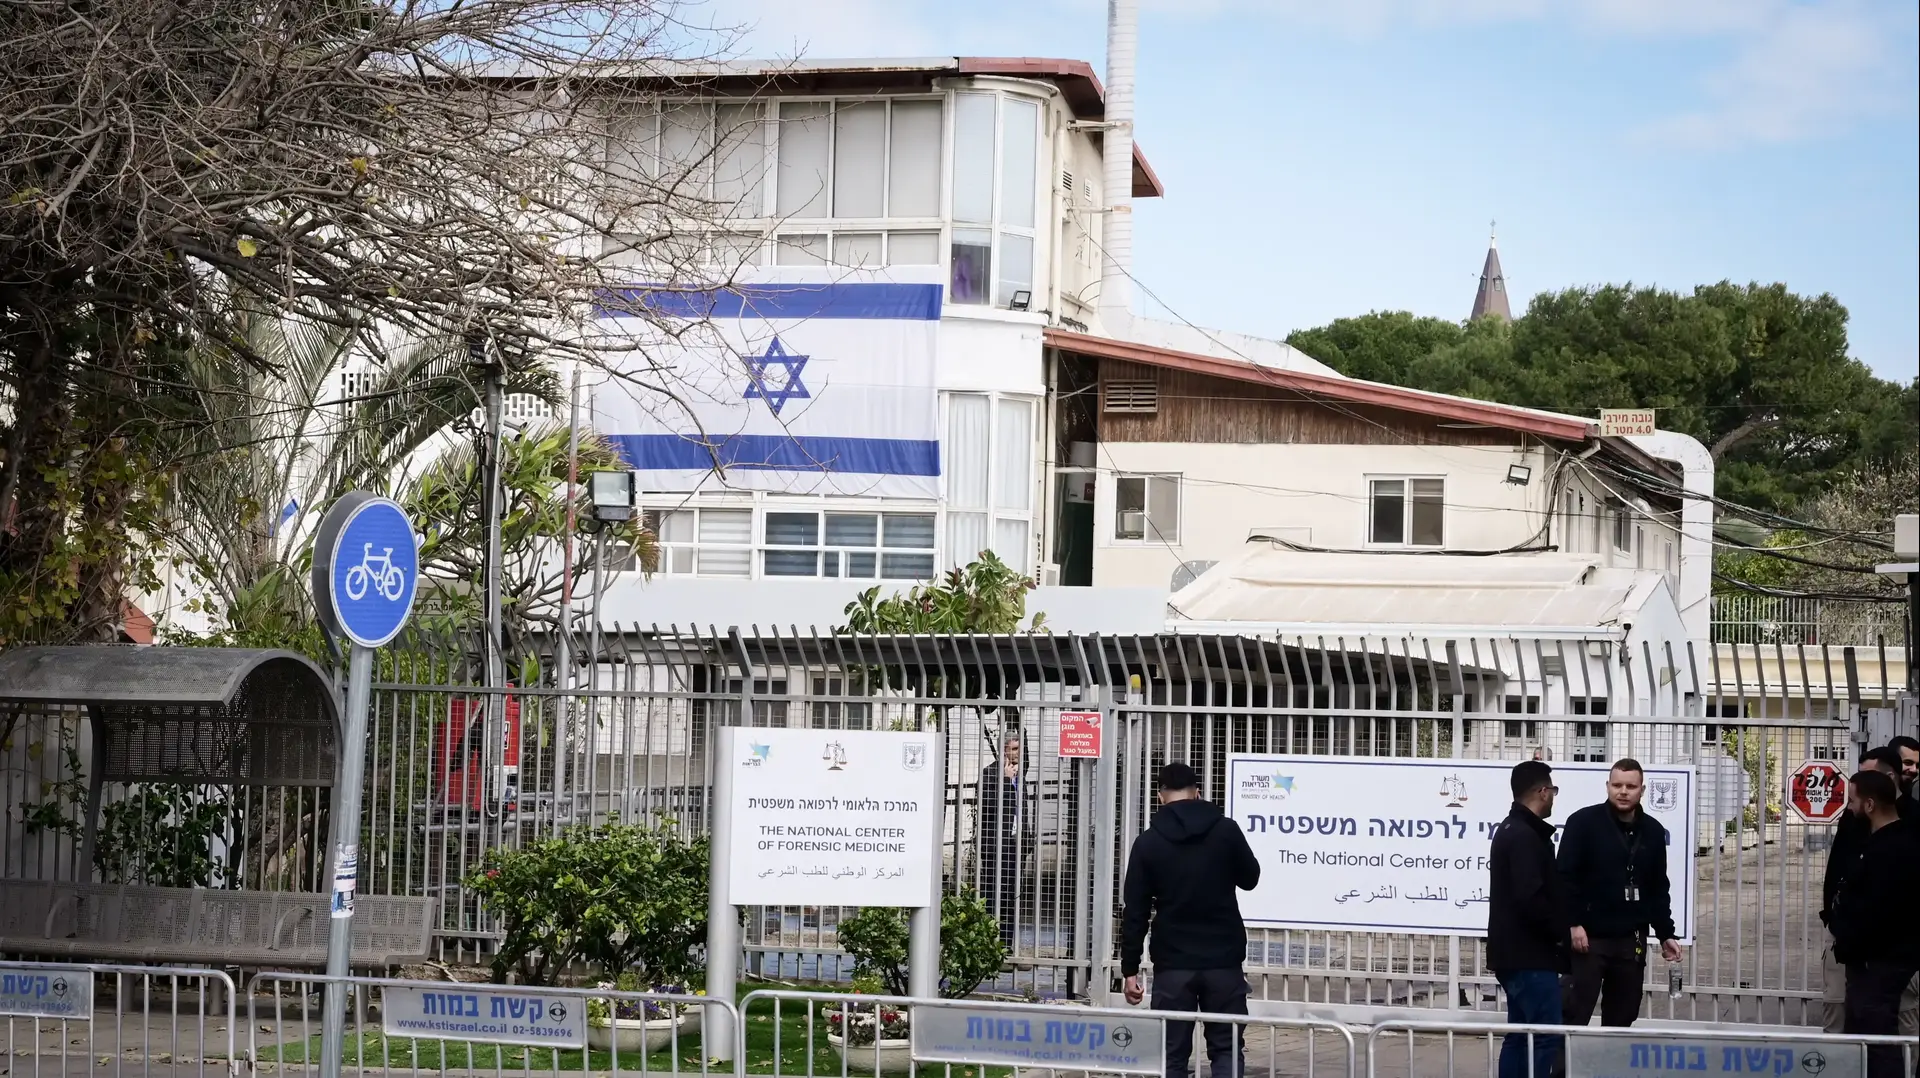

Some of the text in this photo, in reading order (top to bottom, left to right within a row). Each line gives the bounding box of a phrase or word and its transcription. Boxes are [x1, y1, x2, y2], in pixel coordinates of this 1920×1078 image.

[1604, 414, 1652, 423] גובה מירבי
[1614, 425, 1651, 434] 4.0 מטר
[748, 796, 918, 812] המרכז הלאומי לרפואה משפטית
[759, 826, 905, 838] THE NATIONAL CENTER
[1247, 814, 1357, 836] משפטית
[1369, 814, 1467, 839] לרפואה
[758, 841, 905, 853] OF FORENSIC MEDICINE
[1279, 850, 1308, 864] The
[1313, 851, 1384, 867] National
[1390, 853, 1449, 869] Center
[1454, 856, 1472, 870] of
[758, 866, 904, 880] المركز الوطني للطب الشرعي
[1334, 886, 1397, 904] الشرعي
[1405, 886, 1448, 904] للطب
[2, 974, 48, 999] קשת
[422, 992, 543, 1024] קשת במות
[397, 1018, 572, 1038] www.kstisrael.co.il 02-5839696
[966, 1016, 1105, 1050] קשת במות
[1630, 1043, 1794, 1077] קשת במות
